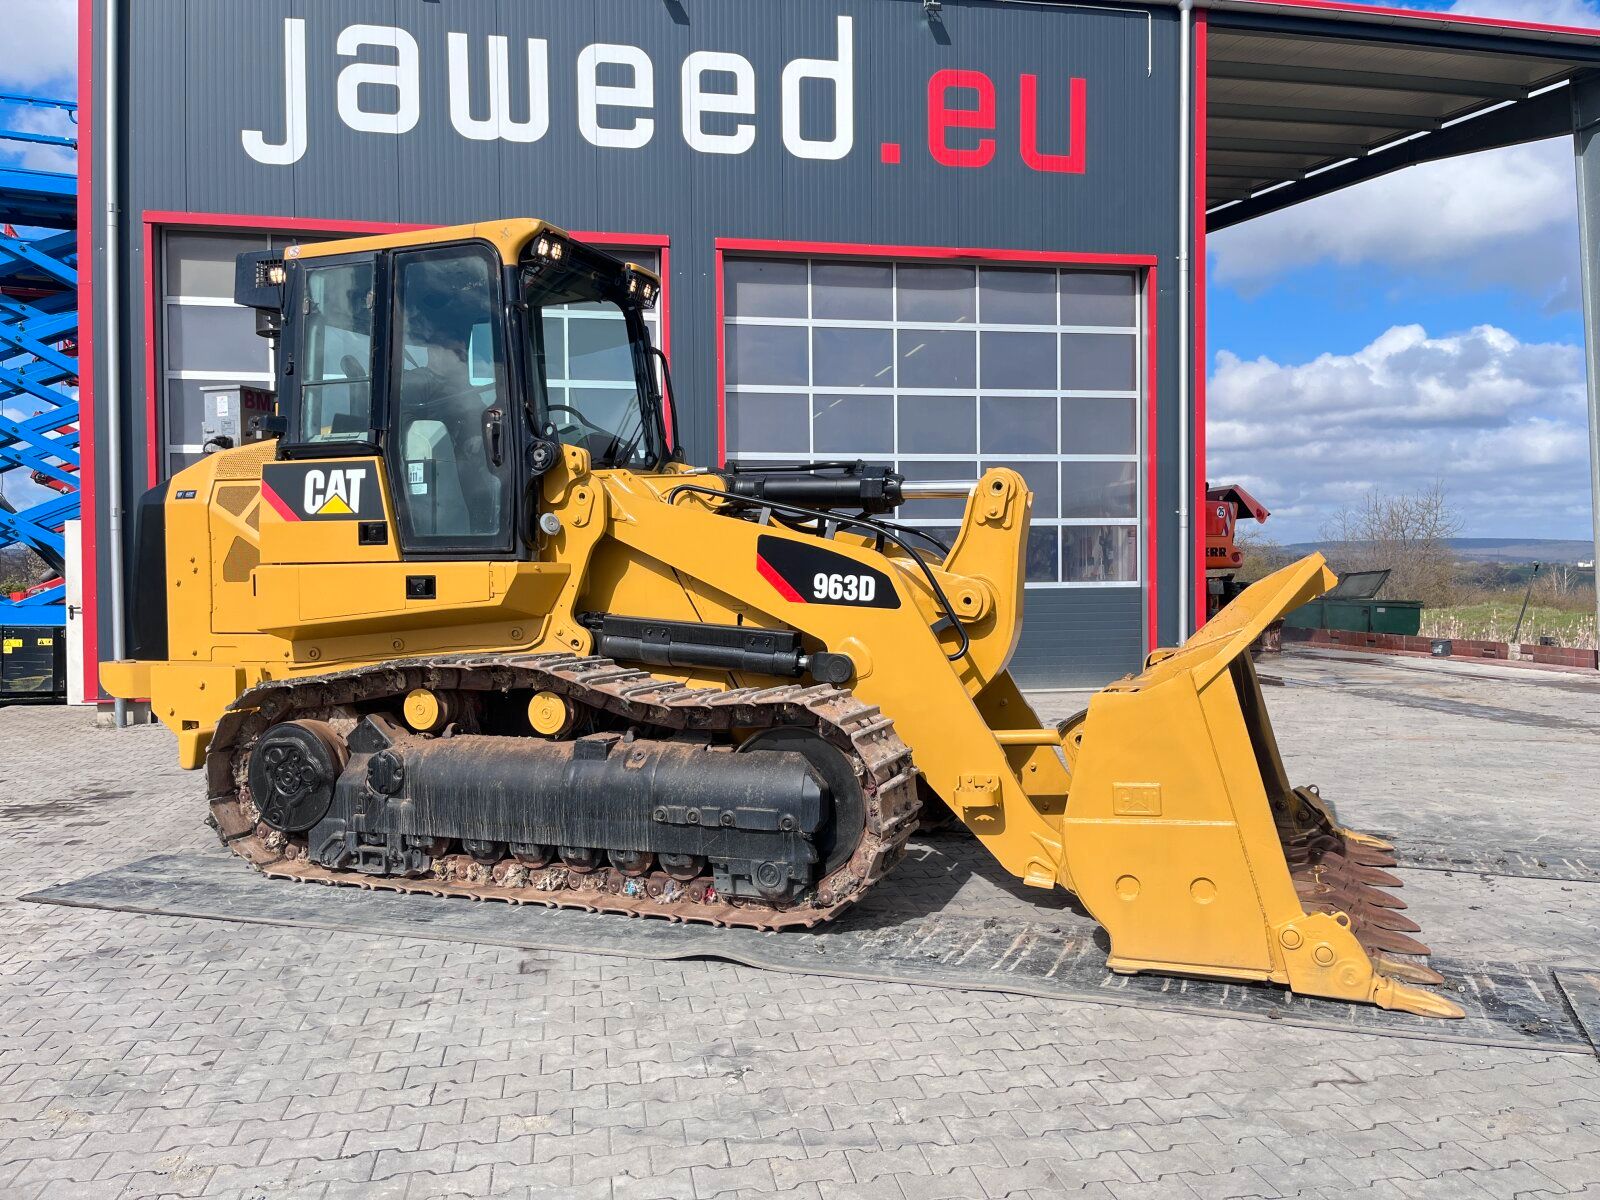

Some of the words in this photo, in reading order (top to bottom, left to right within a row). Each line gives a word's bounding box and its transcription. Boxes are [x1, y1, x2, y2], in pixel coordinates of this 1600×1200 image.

[241, 15, 1087, 174] jaweed.eu
[304, 469, 366, 514] CAT
[813, 573, 876, 601] 963D
